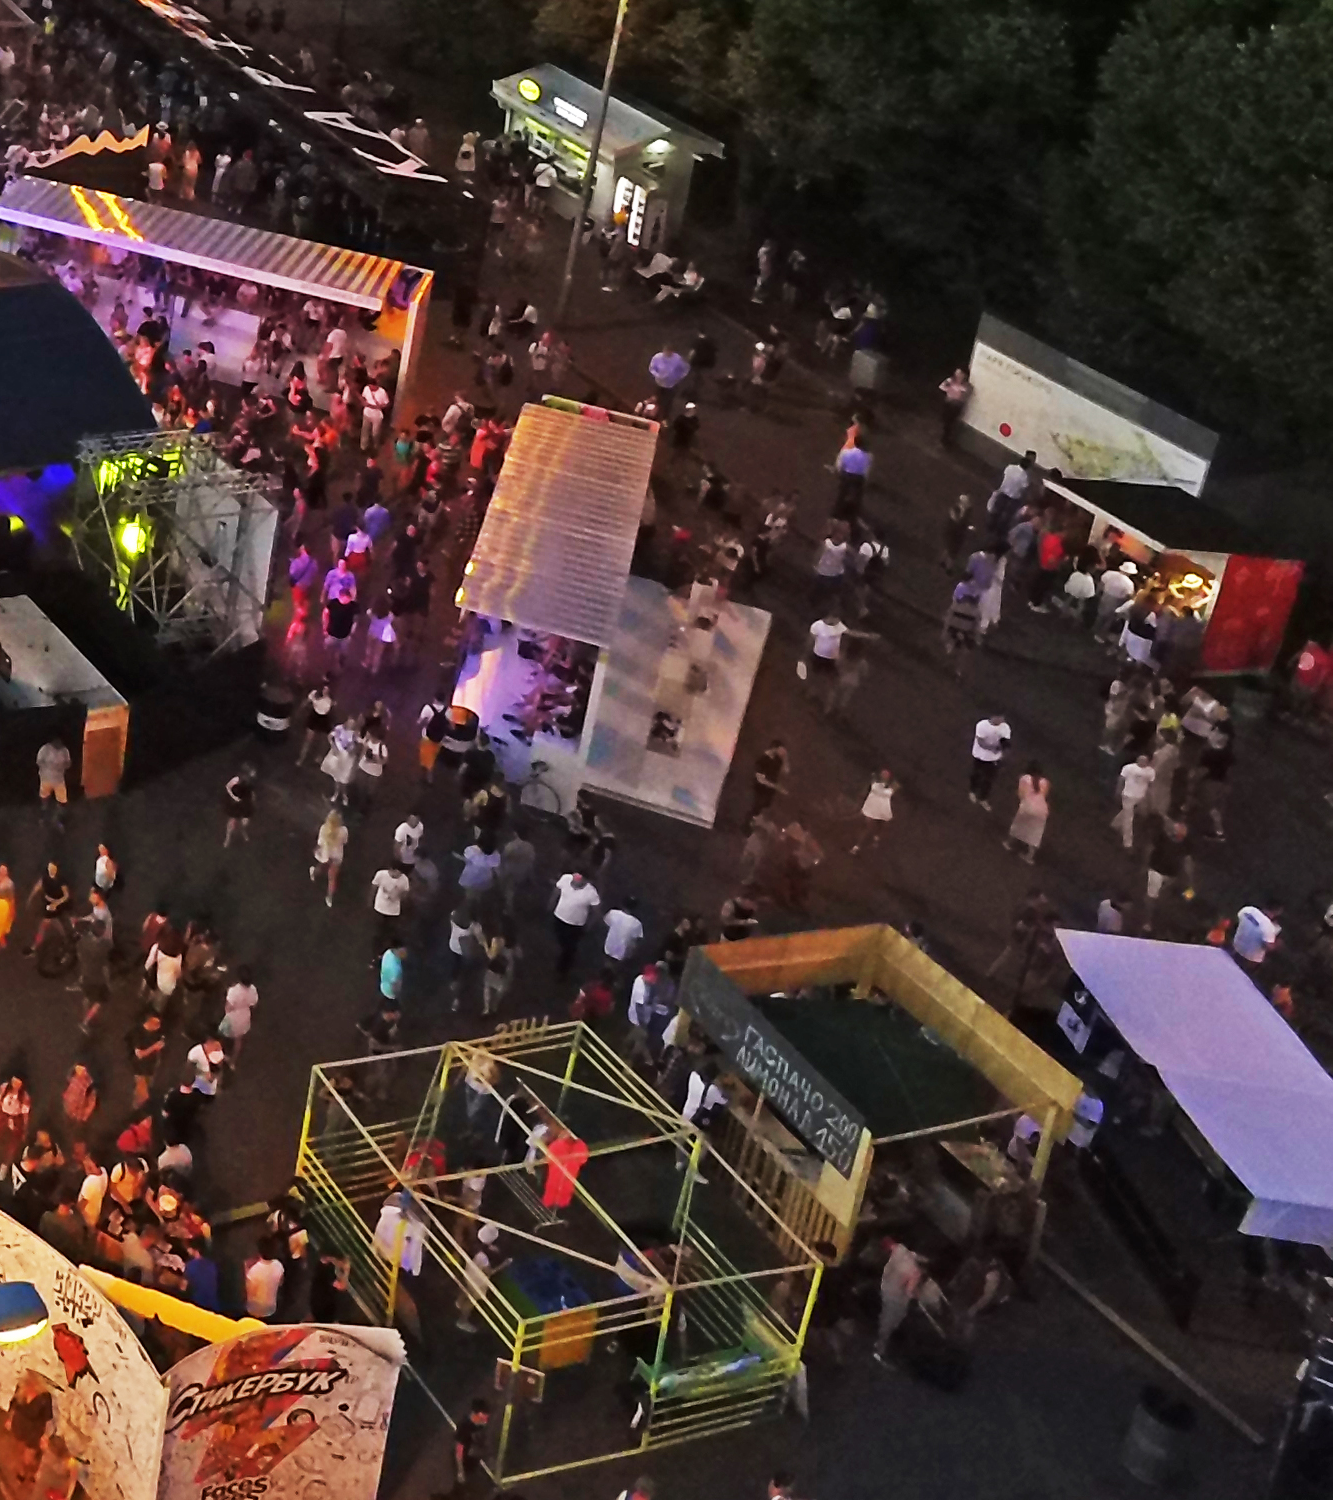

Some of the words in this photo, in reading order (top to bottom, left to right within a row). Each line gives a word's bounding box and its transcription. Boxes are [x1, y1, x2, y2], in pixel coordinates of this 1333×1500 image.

[744, 1024, 825, 1113] ГАСПАЧО
[825, 1103, 860, 1145] 200
[166, 1369, 344, 1431] СТИКЕРБУК
